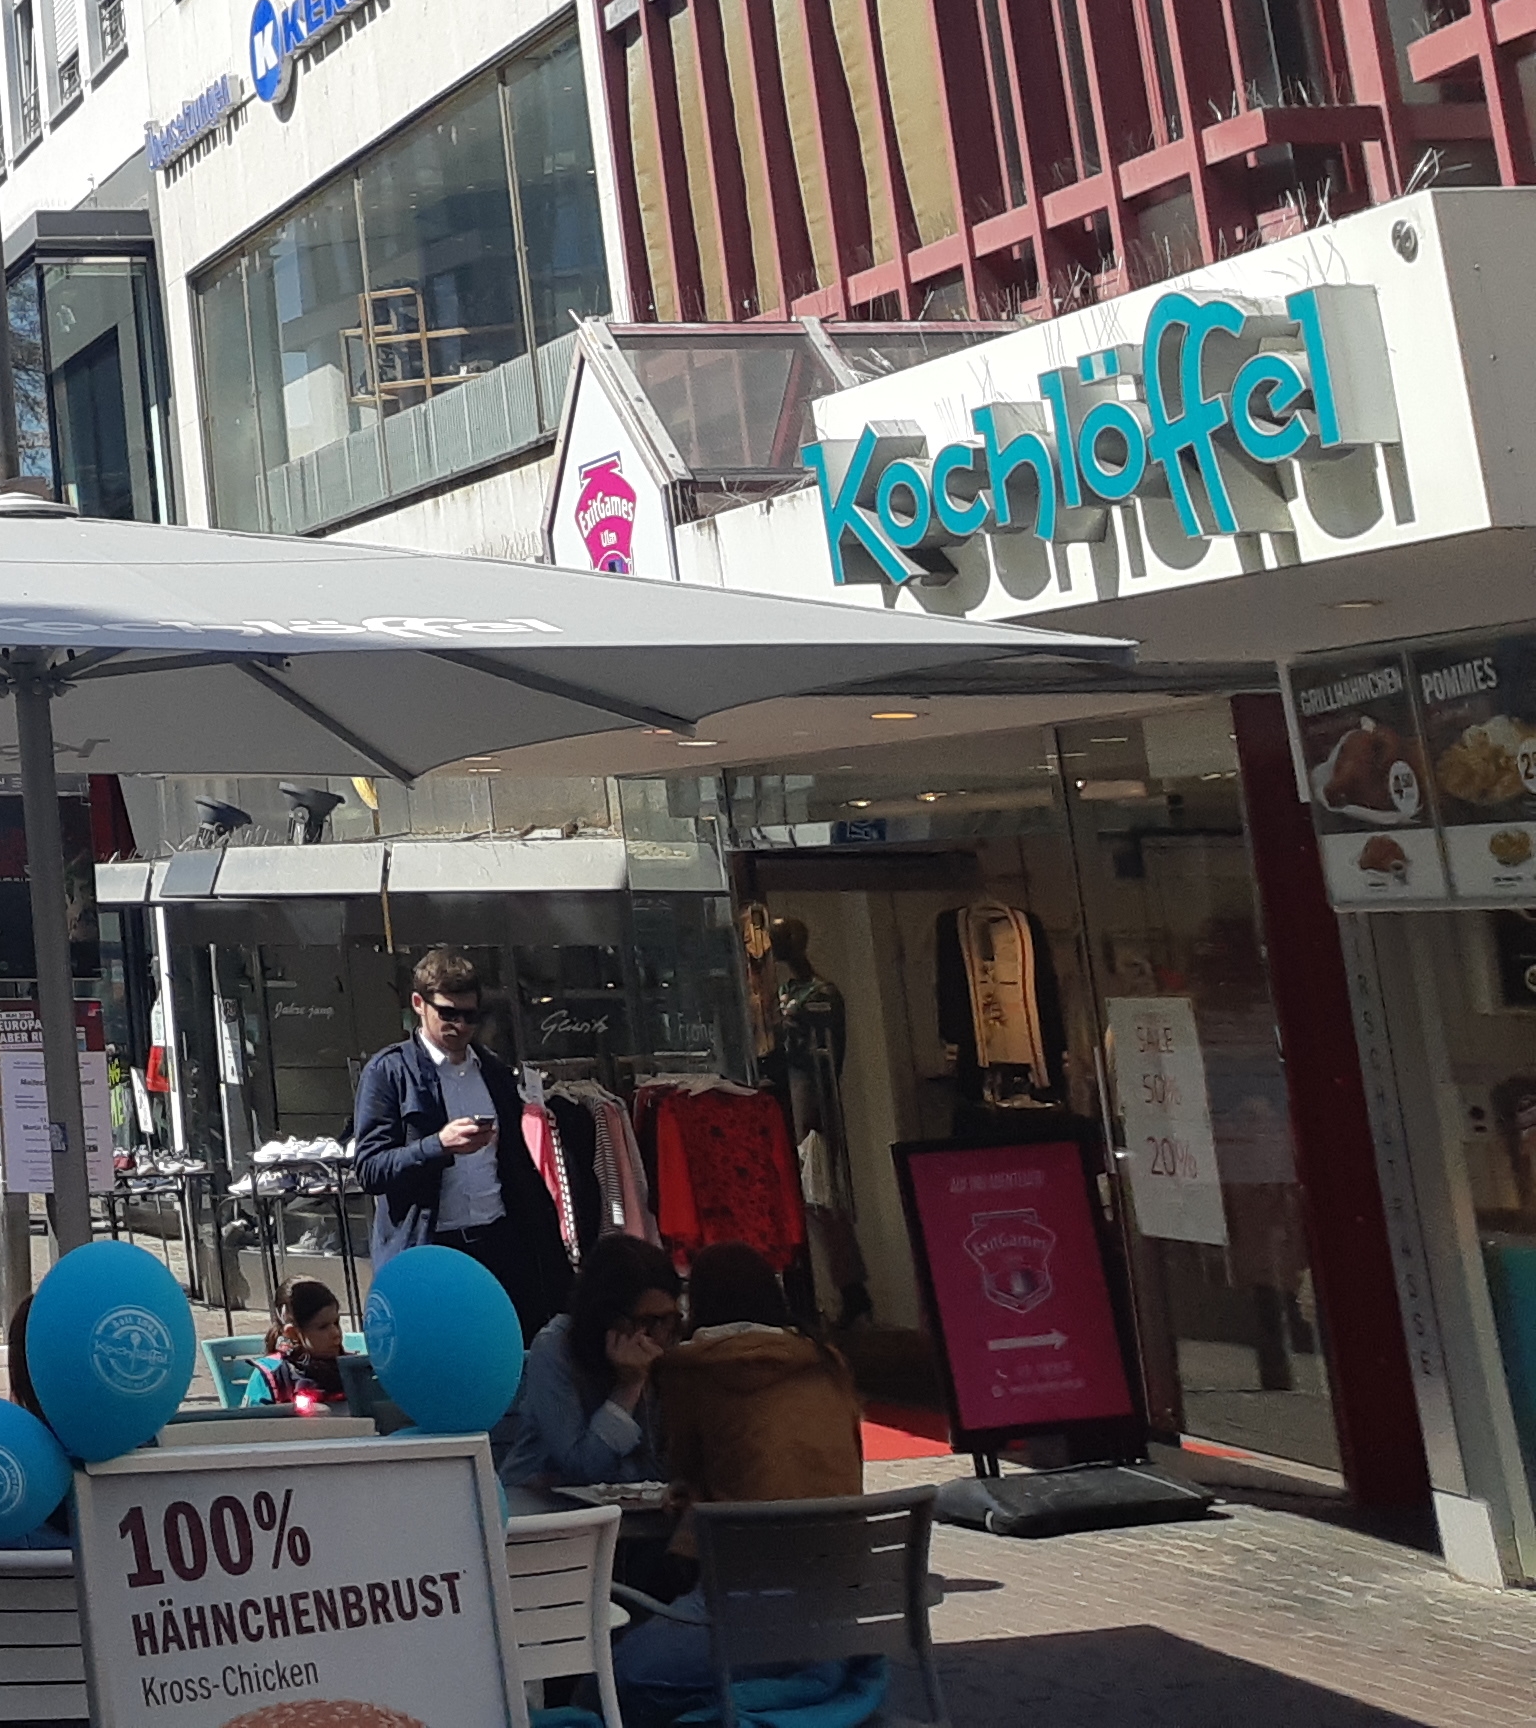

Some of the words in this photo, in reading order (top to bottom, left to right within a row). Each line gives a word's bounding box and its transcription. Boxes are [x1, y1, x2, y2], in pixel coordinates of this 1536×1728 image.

[800, 291, 1344, 586] Kochlöffel
[578, 492, 634, 539] ExitGames
[600, 530, 617, 547] Ulm
[1421, 657, 1499, 704] POMMES
[0, 1032, 28, 1043] ABER
[1136, 1026, 1175, 1053] SALE
[1143, 1074, 1181, 1105] 50%
[1146, 1137, 1198, 1179] 20%
[118, 1488, 311, 1588] 100%
[131, 1571, 462, 1657] HÄHNCHENBRUST
[141, 1660, 320, 1707] Kross-Chicken
